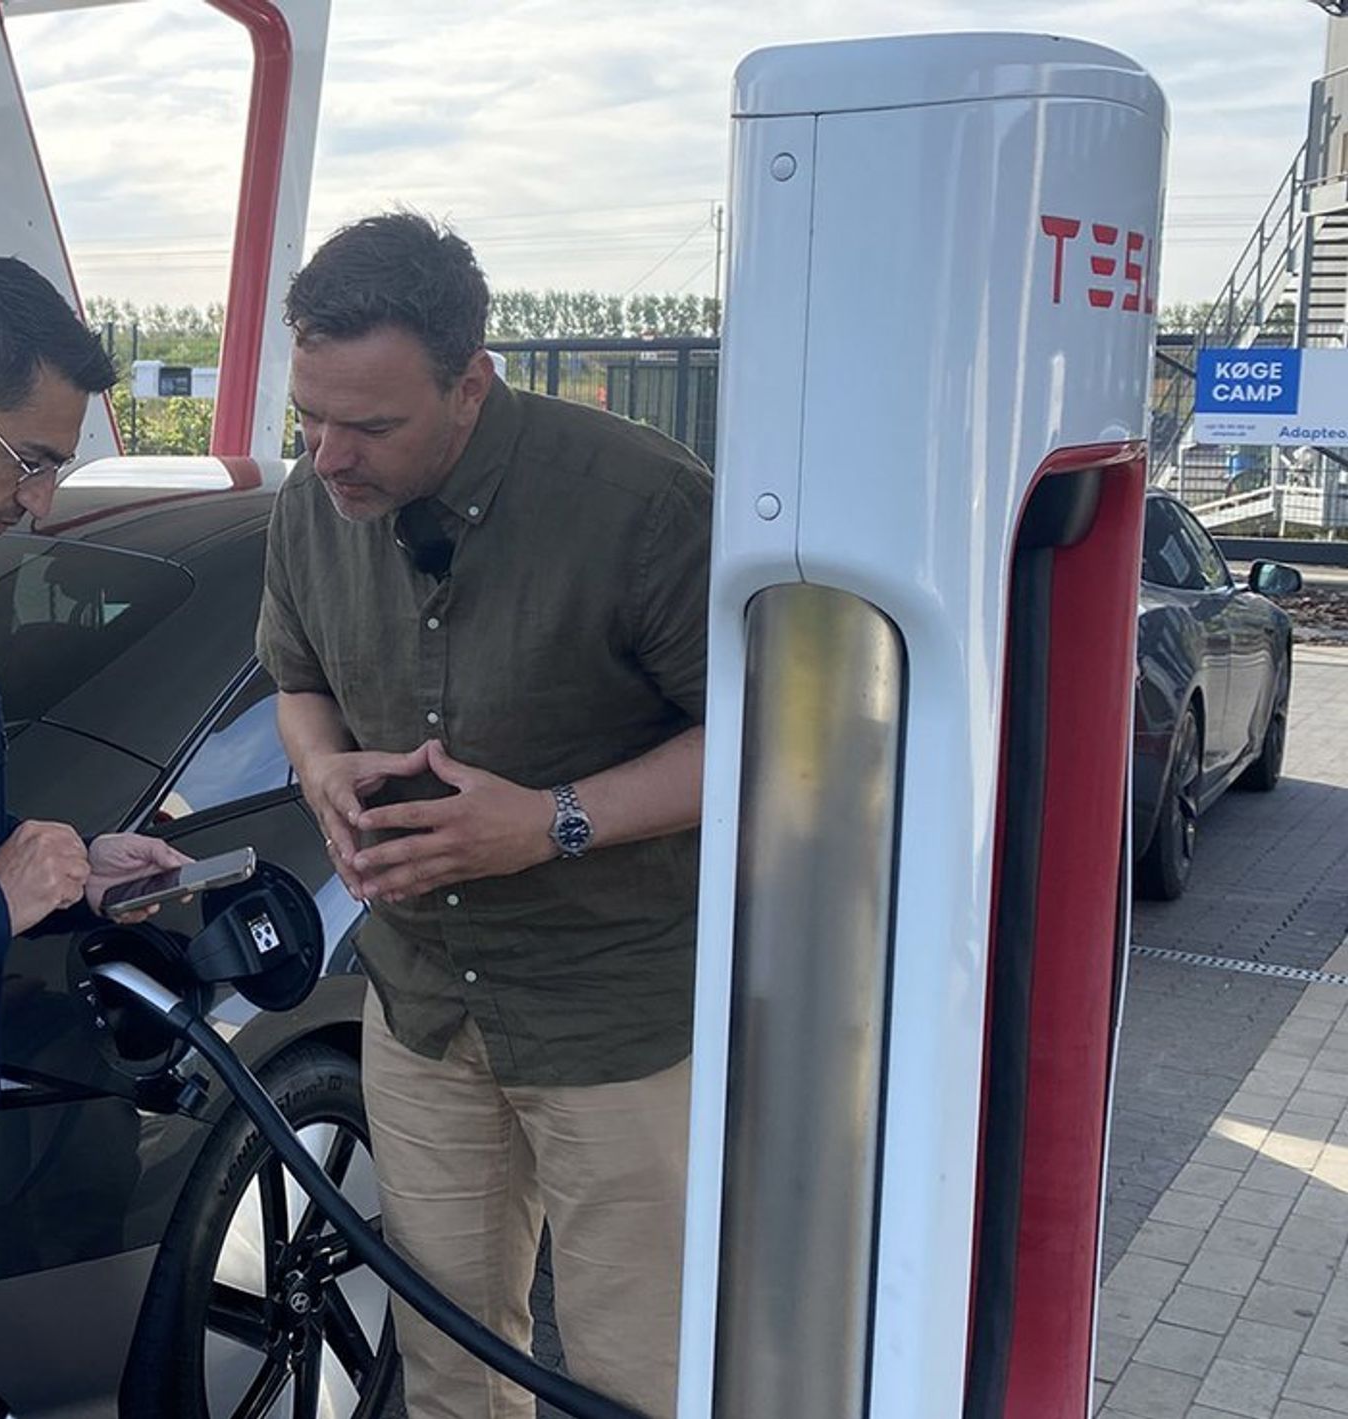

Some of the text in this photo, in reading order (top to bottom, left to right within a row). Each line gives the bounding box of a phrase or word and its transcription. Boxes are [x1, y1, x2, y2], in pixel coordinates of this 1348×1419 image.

[1040, 215, 1153, 314] TESL
[1215, 362, 1283, 379] KØGE
[1212, 383, 1283, 401] CAMP
